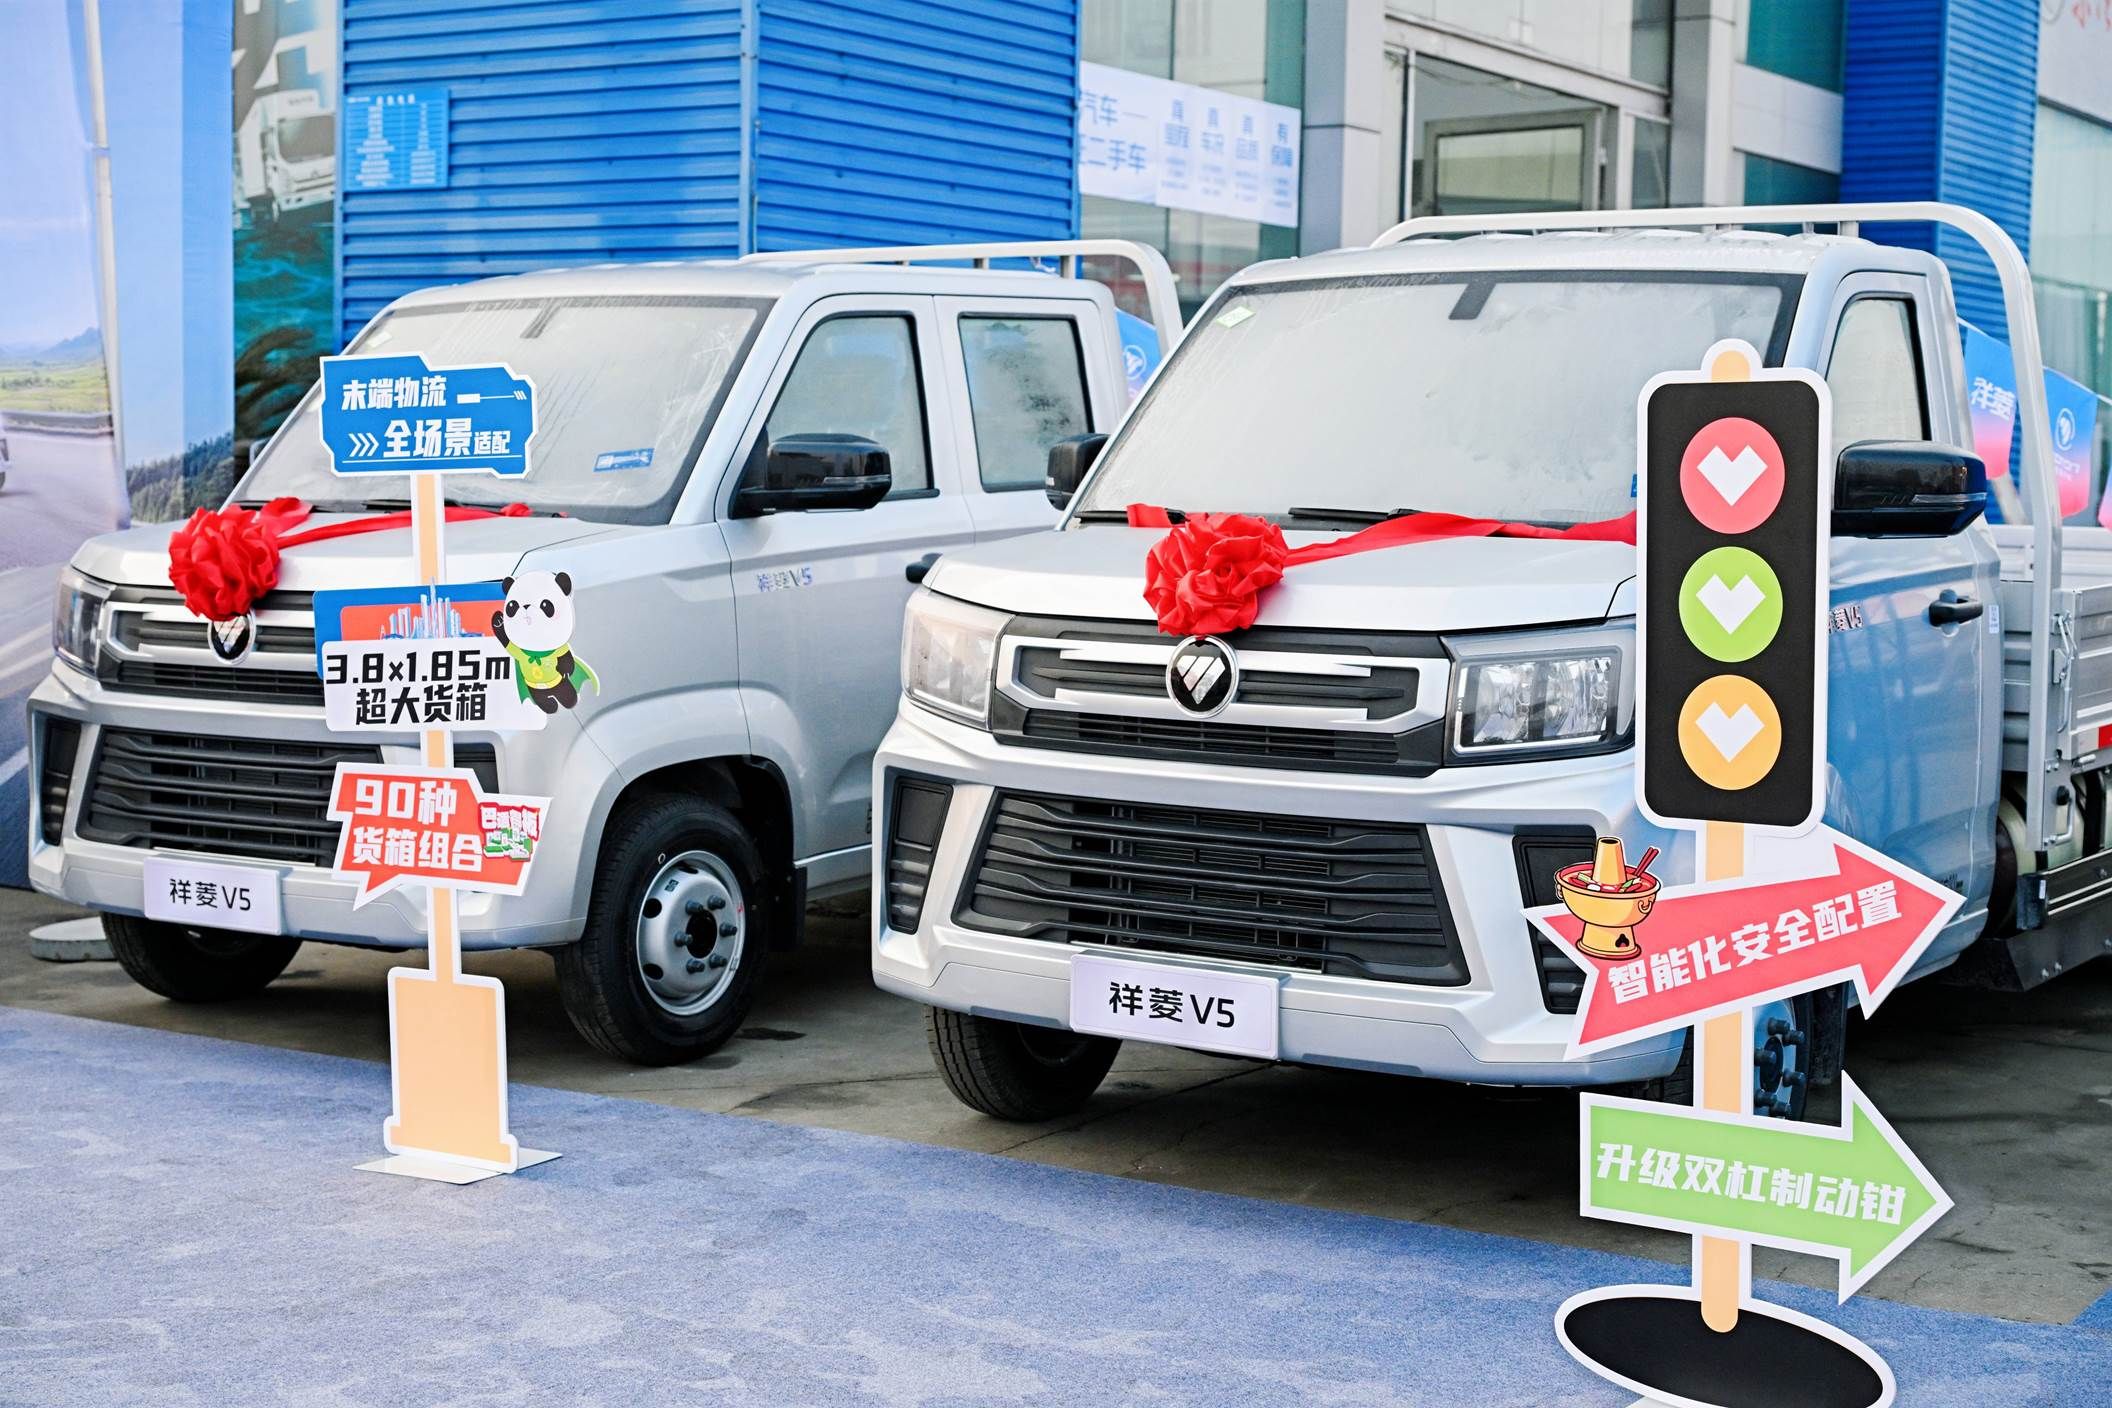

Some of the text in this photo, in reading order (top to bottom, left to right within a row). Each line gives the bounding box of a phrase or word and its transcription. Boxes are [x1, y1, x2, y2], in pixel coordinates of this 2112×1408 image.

[341, 374, 447, 411] 末端物流
[383, 417, 511, 458] 全场景适配
[356, 682, 488, 726] 超大货箱
[354, 778, 458, 828] 90种
[352, 826, 483, 872] 货箱组合
[169, 878, 252, 912] 祥菱V5
[1607, 879, 1903, 1005] 智能化安全配置
[1109, 981, 1236, 1029] 祥菱V5
[1596, 1141, 1907, 1226] 升级双杠制动钳
